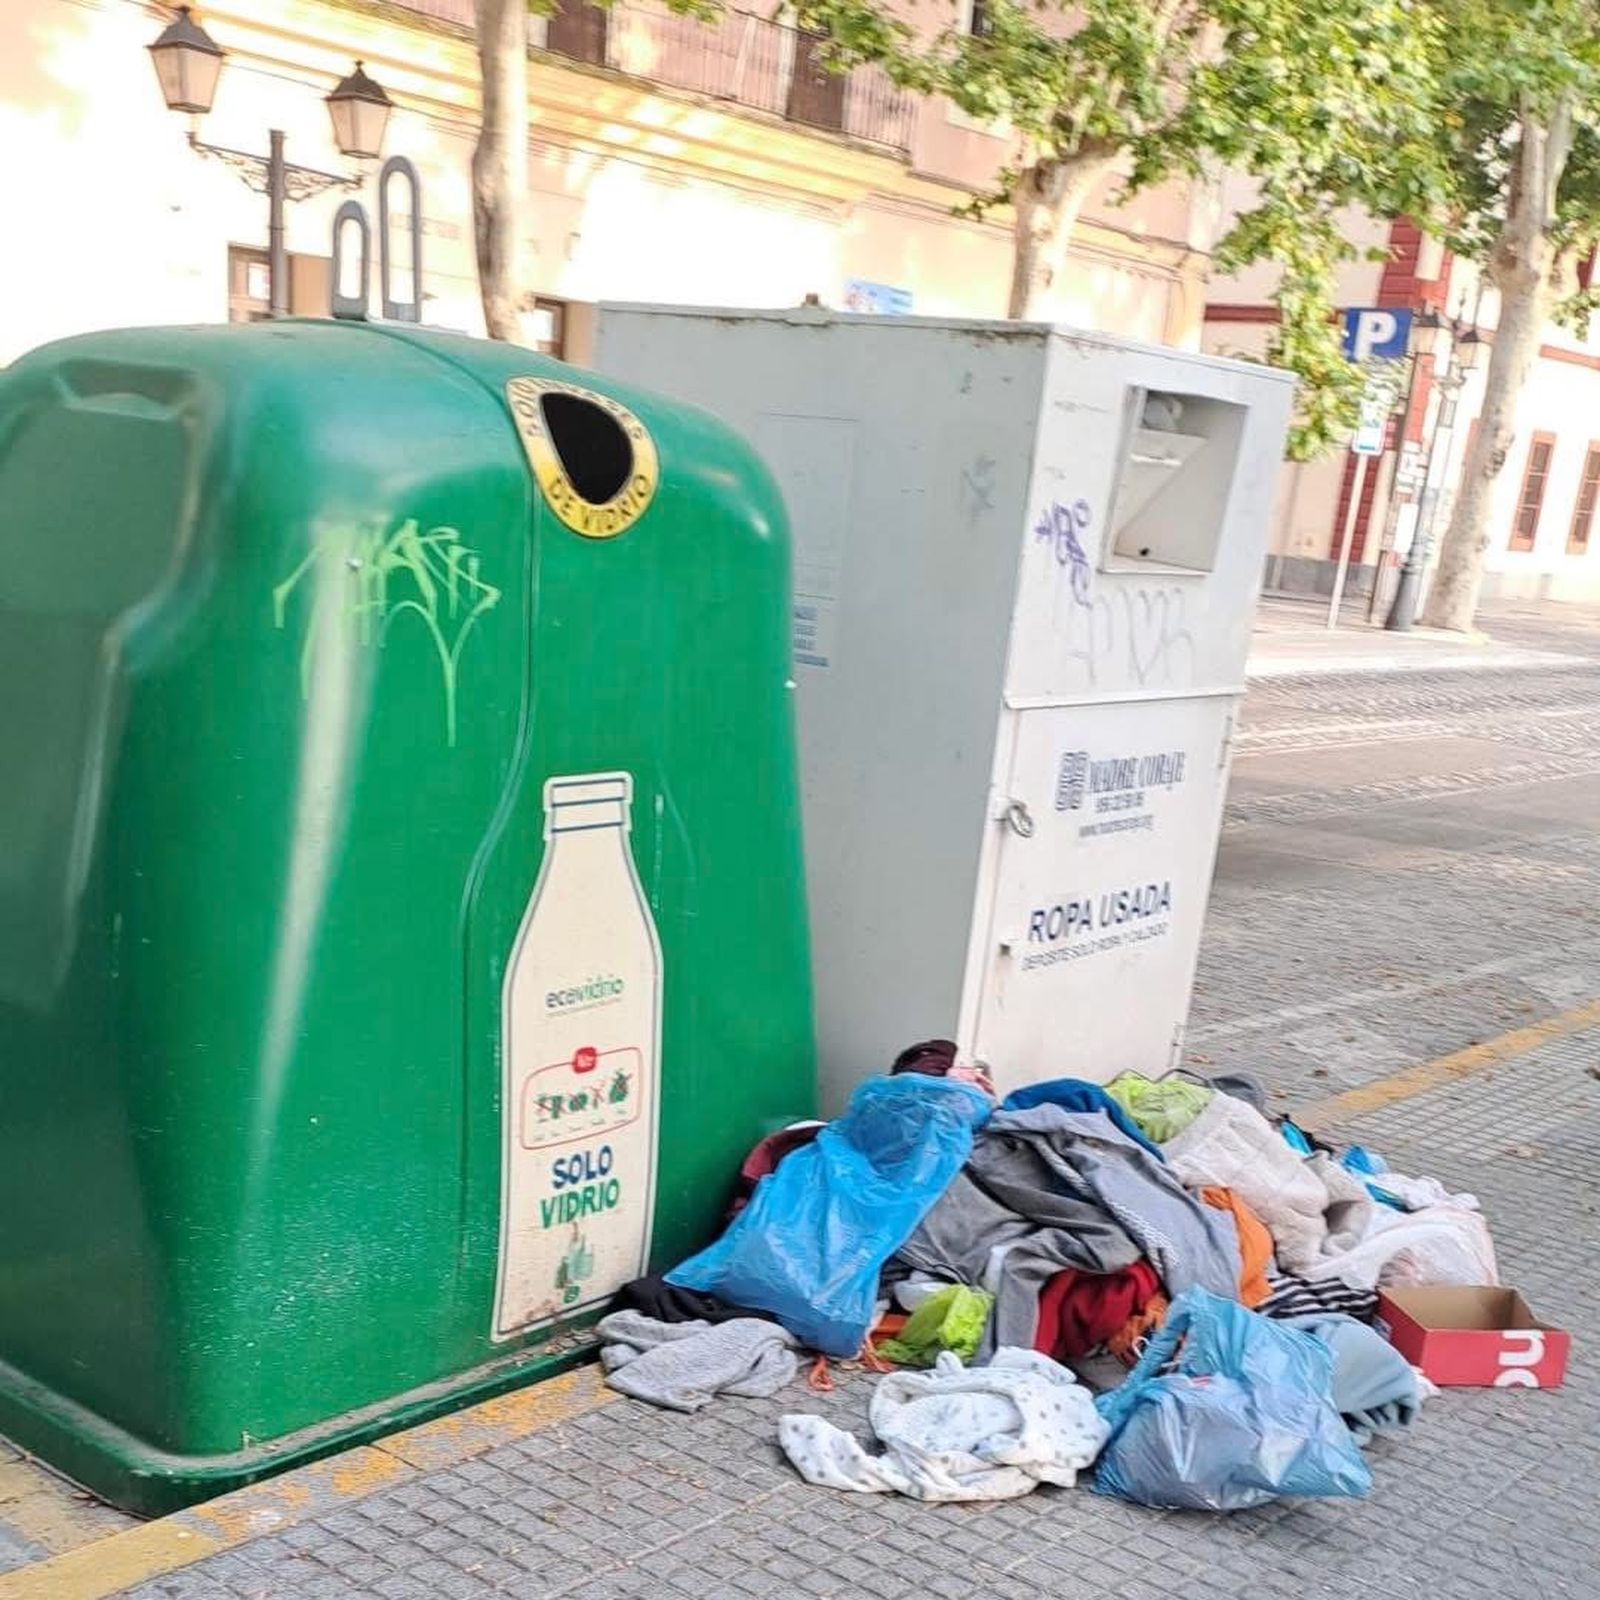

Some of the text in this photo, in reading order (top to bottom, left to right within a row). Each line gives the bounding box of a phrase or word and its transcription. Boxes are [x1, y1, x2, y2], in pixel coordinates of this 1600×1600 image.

[1353, 311, 1398, 362] P
[1028, 881, 1171, 943] ROPA USADA
[552, 1145, 613, 1189] SOLO
[540, 1178, 620, 1230] VIDRIO
